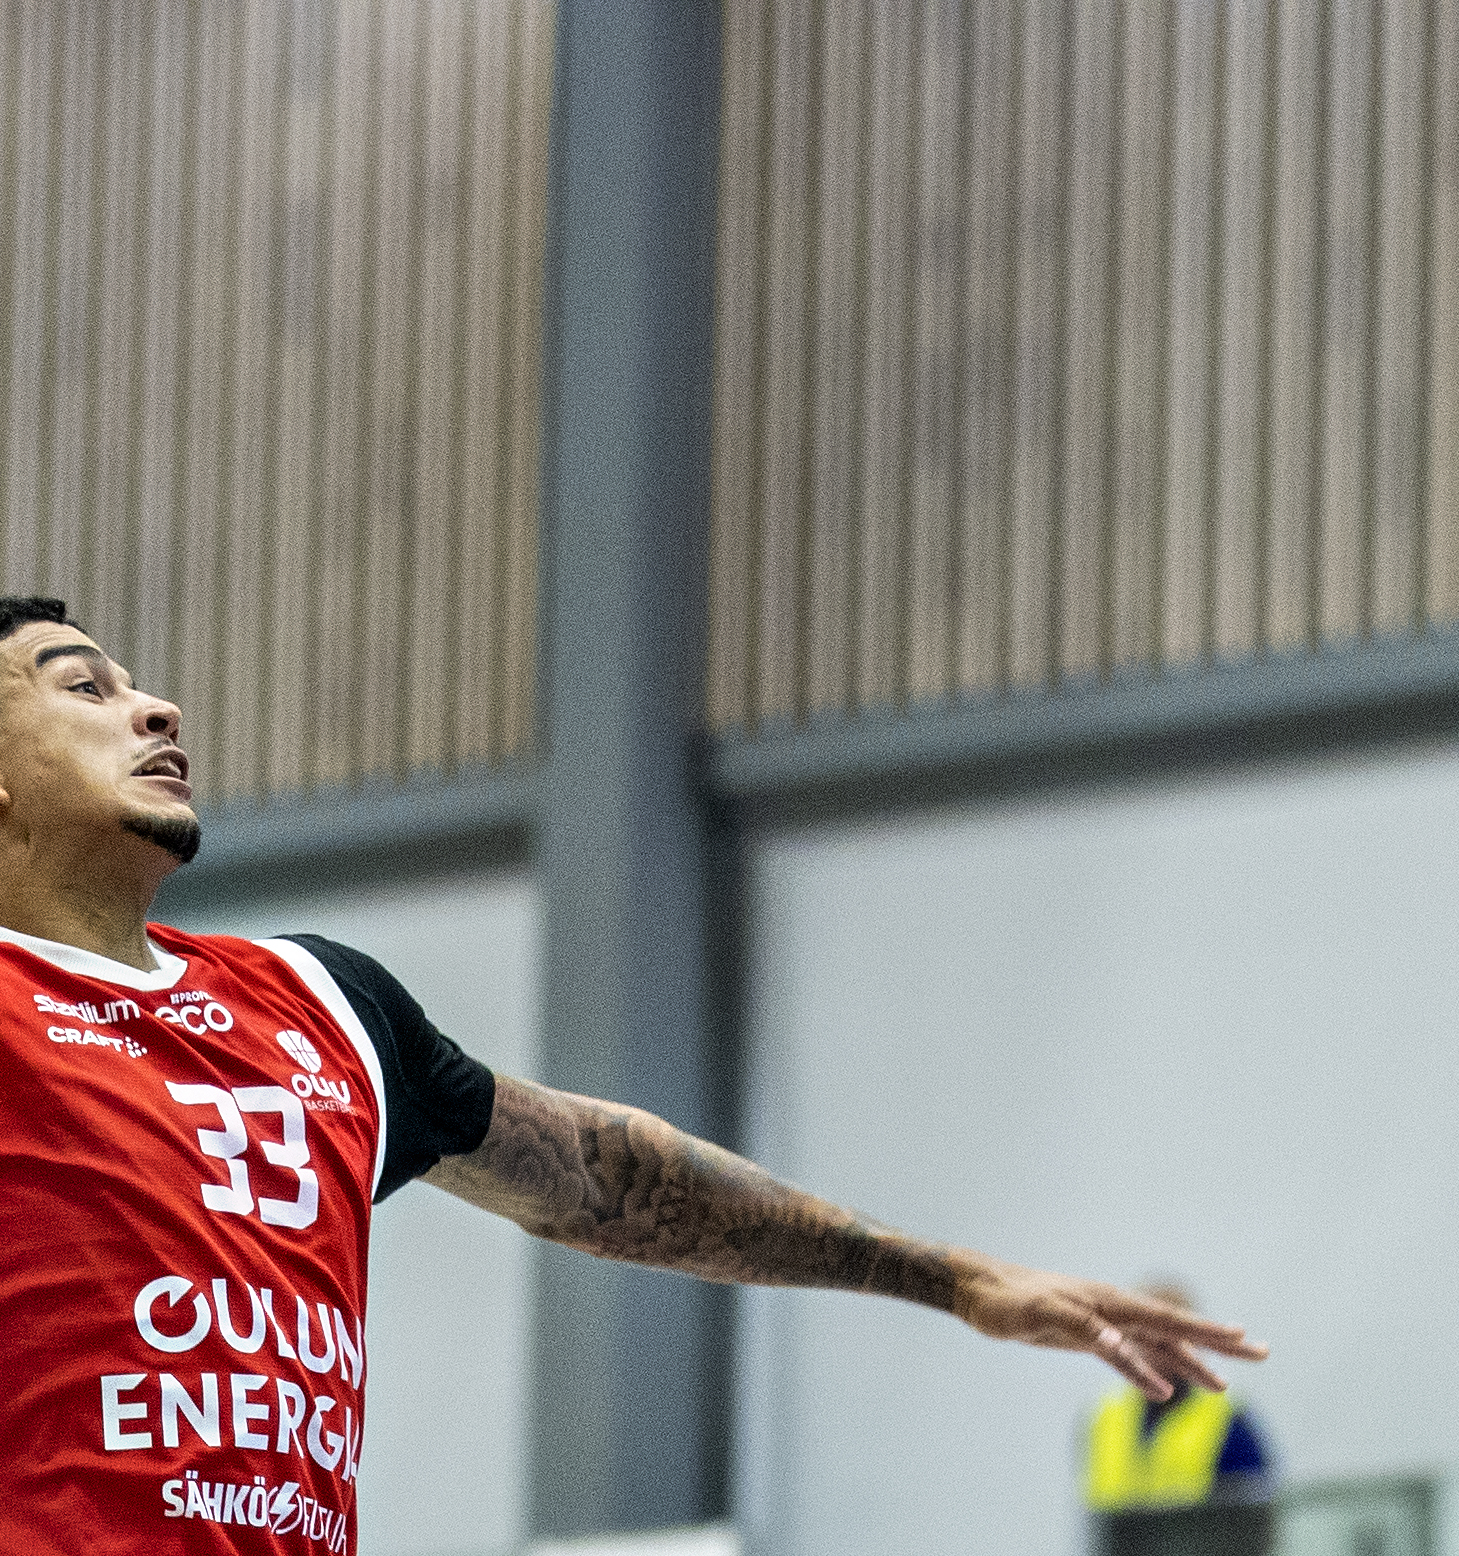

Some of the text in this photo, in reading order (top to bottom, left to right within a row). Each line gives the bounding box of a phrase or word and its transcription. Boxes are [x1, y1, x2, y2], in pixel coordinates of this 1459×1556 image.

[33, 993, 142, 1025] Stadium
[46, 1025, 124, 1053] CRAFT
[164, 1080, 320, 1231] 33
[134, 1275, 364, 1391] OULUN
[161, 1470, 269, 1528] SÄHKÖ
